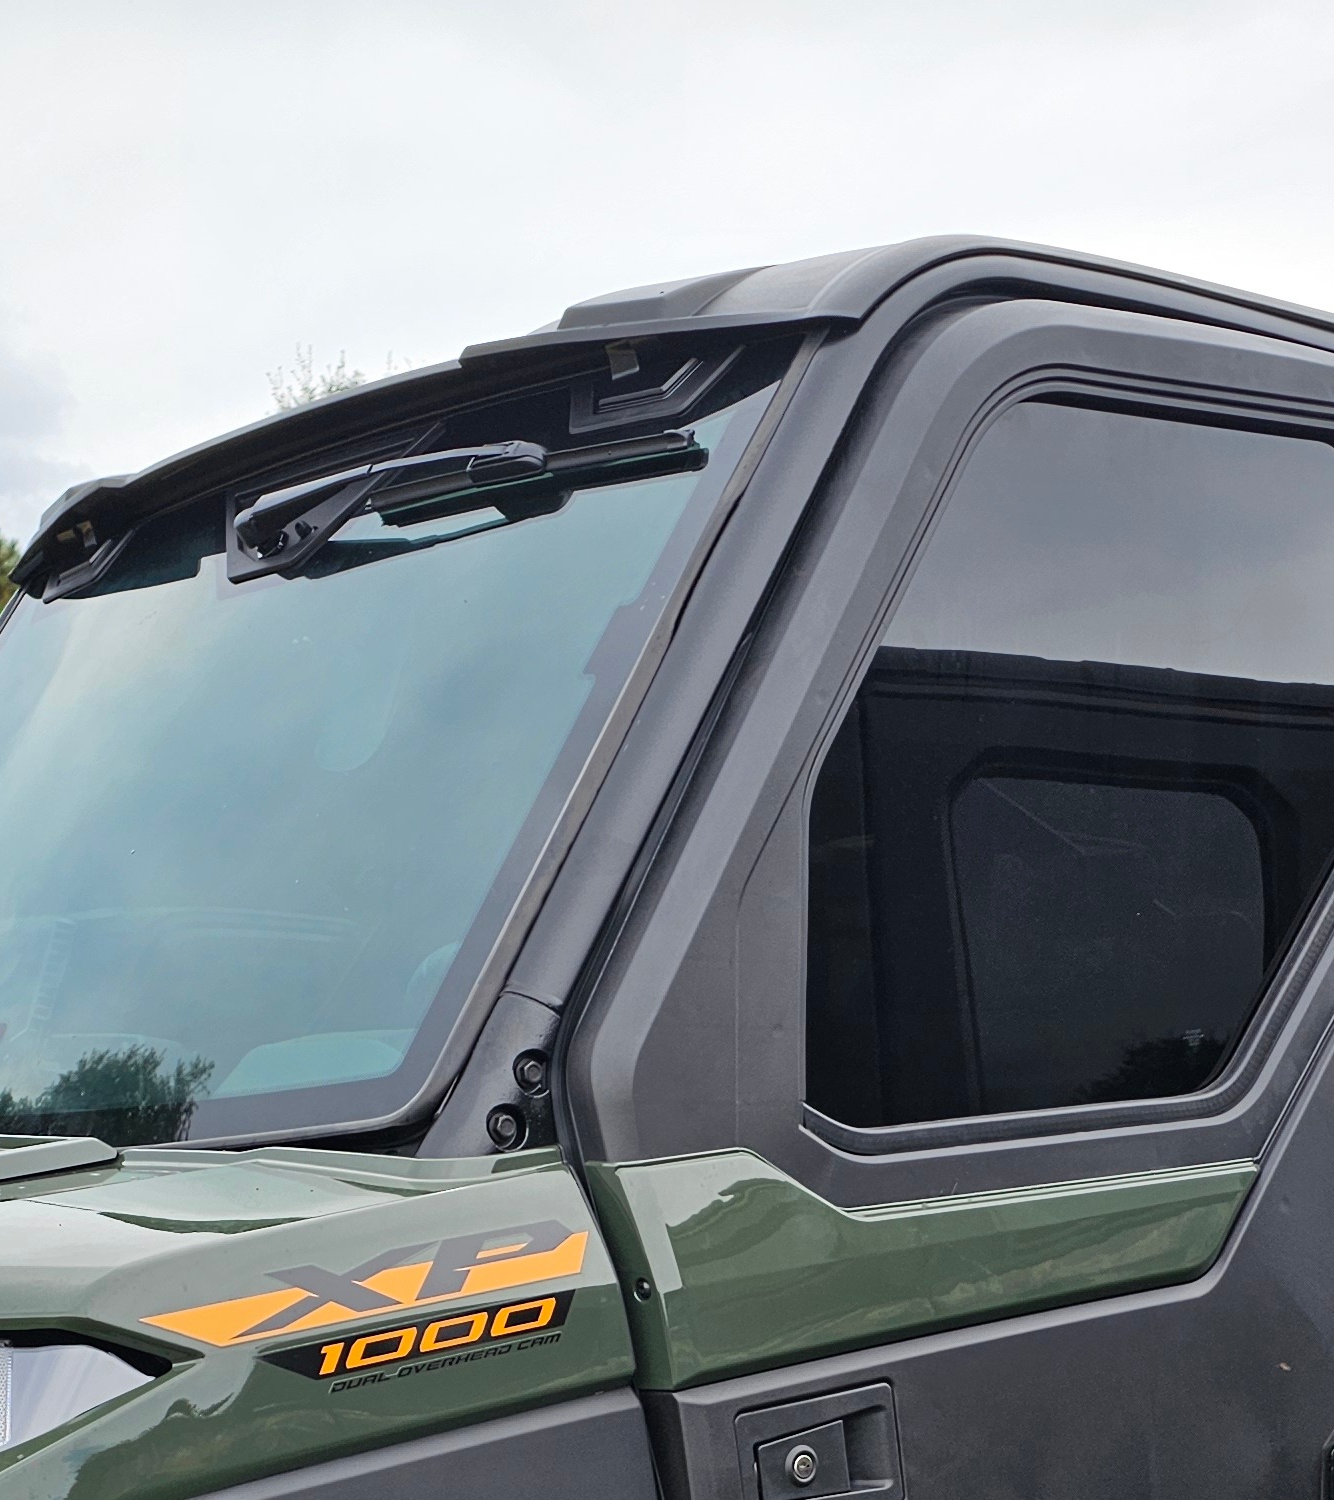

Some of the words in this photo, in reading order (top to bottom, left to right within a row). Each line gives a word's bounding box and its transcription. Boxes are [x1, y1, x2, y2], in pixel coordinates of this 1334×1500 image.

[230, 1218, 577, 1340] XP
[318, 1296, 558, 1376] 1000
[330, 1370, 393, 1393] DUAL
[396, 1344, 512, 1378] OVERHEAD
[516, 1331, 563, 1351] CAM
